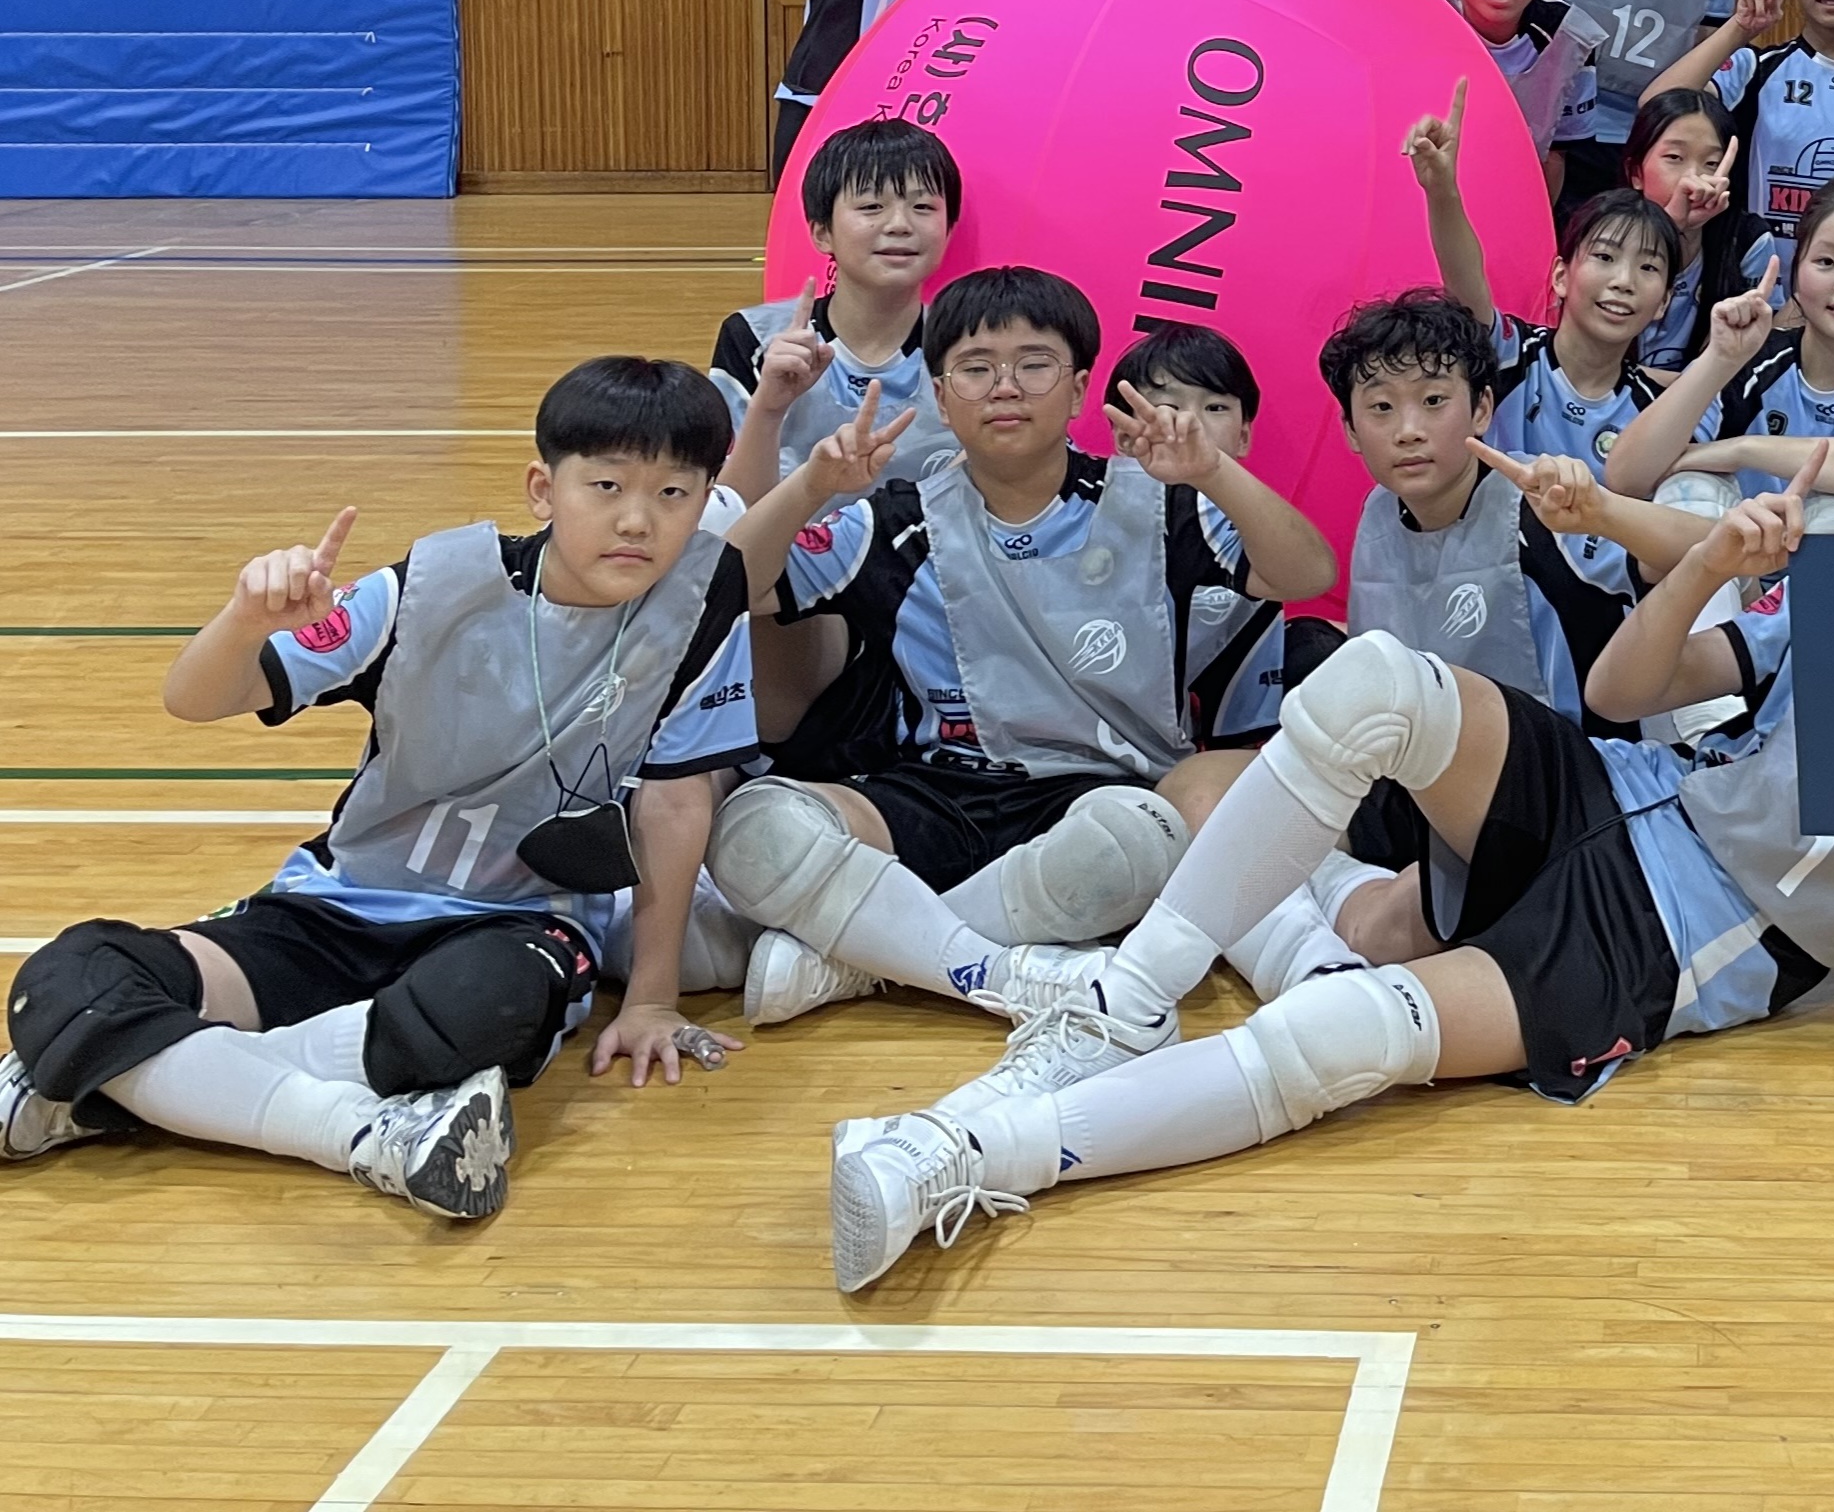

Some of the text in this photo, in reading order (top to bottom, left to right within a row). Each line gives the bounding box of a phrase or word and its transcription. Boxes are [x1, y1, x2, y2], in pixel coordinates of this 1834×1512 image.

[886, 18, 948, 90] Korea
[1609, 4, 1665, 69] 12
[1783, 79, 1814, 107] 12
[1131, 37, 1265, 336] OMNI
